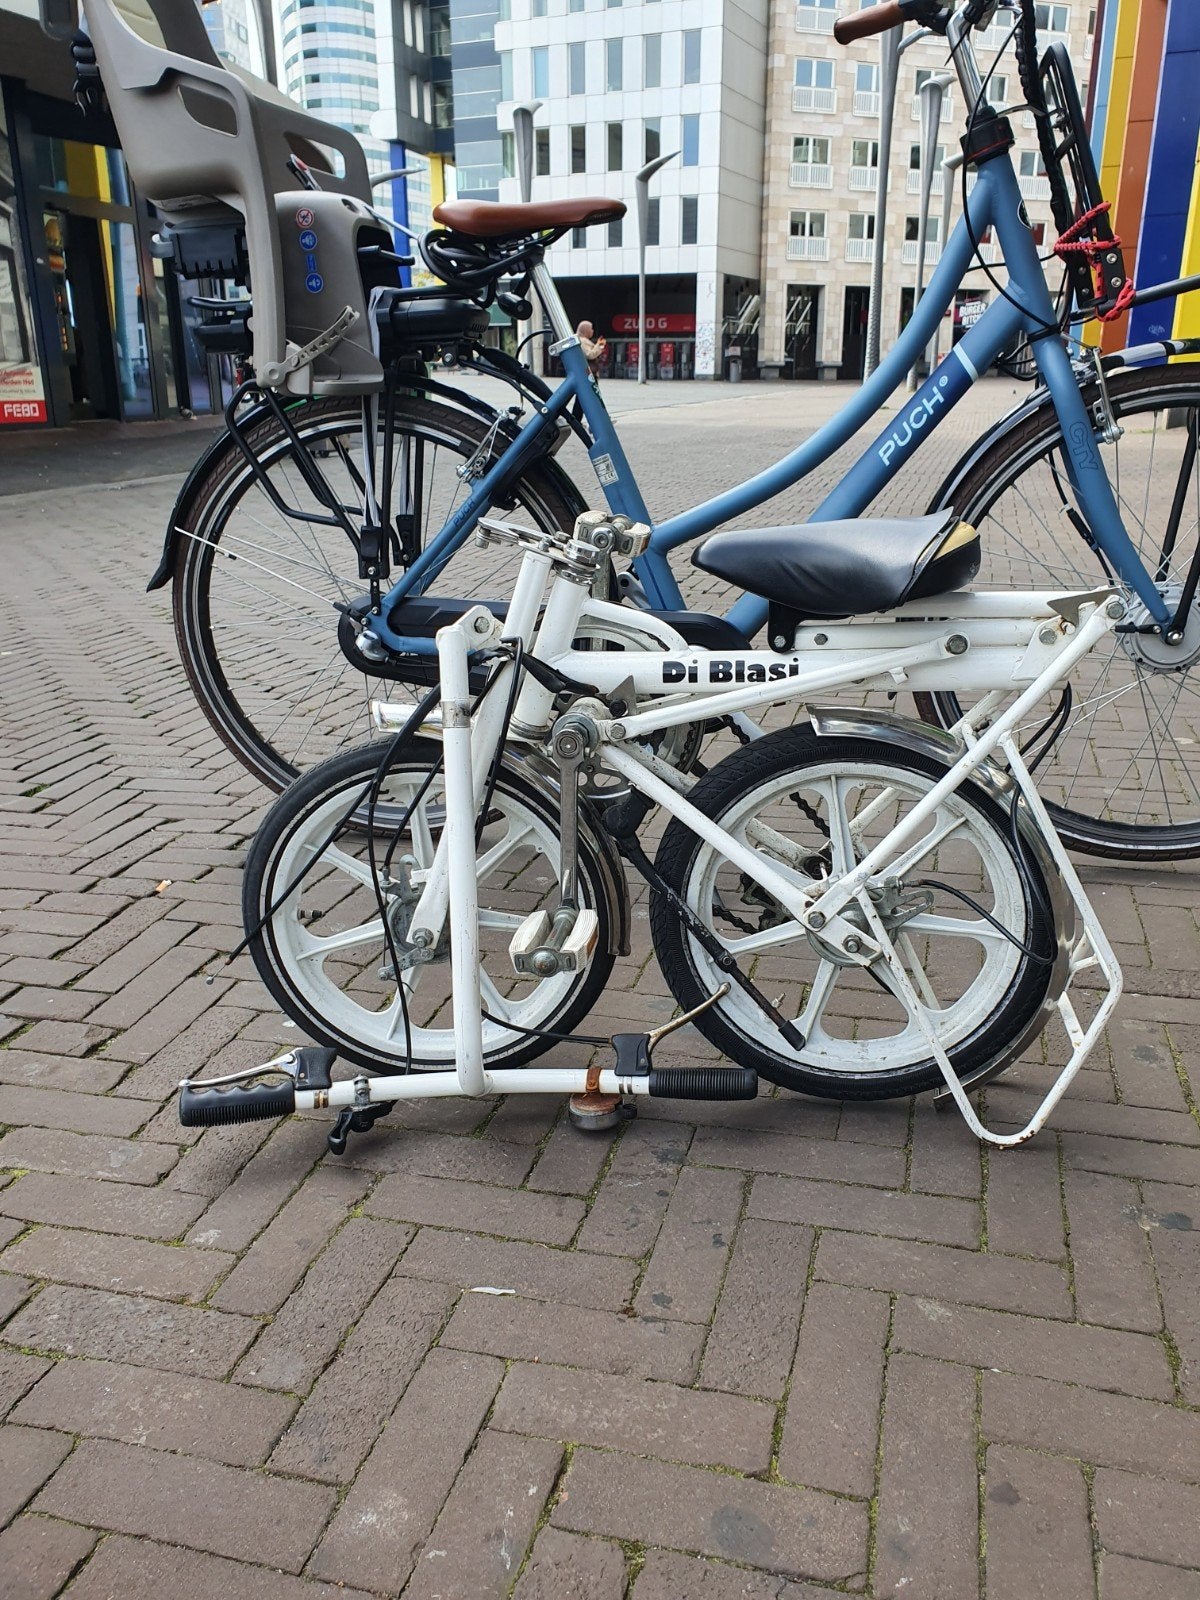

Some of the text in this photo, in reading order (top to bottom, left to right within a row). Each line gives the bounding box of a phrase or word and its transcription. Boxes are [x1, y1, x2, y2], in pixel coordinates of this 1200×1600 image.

[624, 318, 668, 329] ZUD G
[3, 403, 40, 418] FEBO
[878, 386, 944, 466] PUCH
[453, 499, 475, 527] PUCH
[662, 657, 799, 684] Di Blasi
